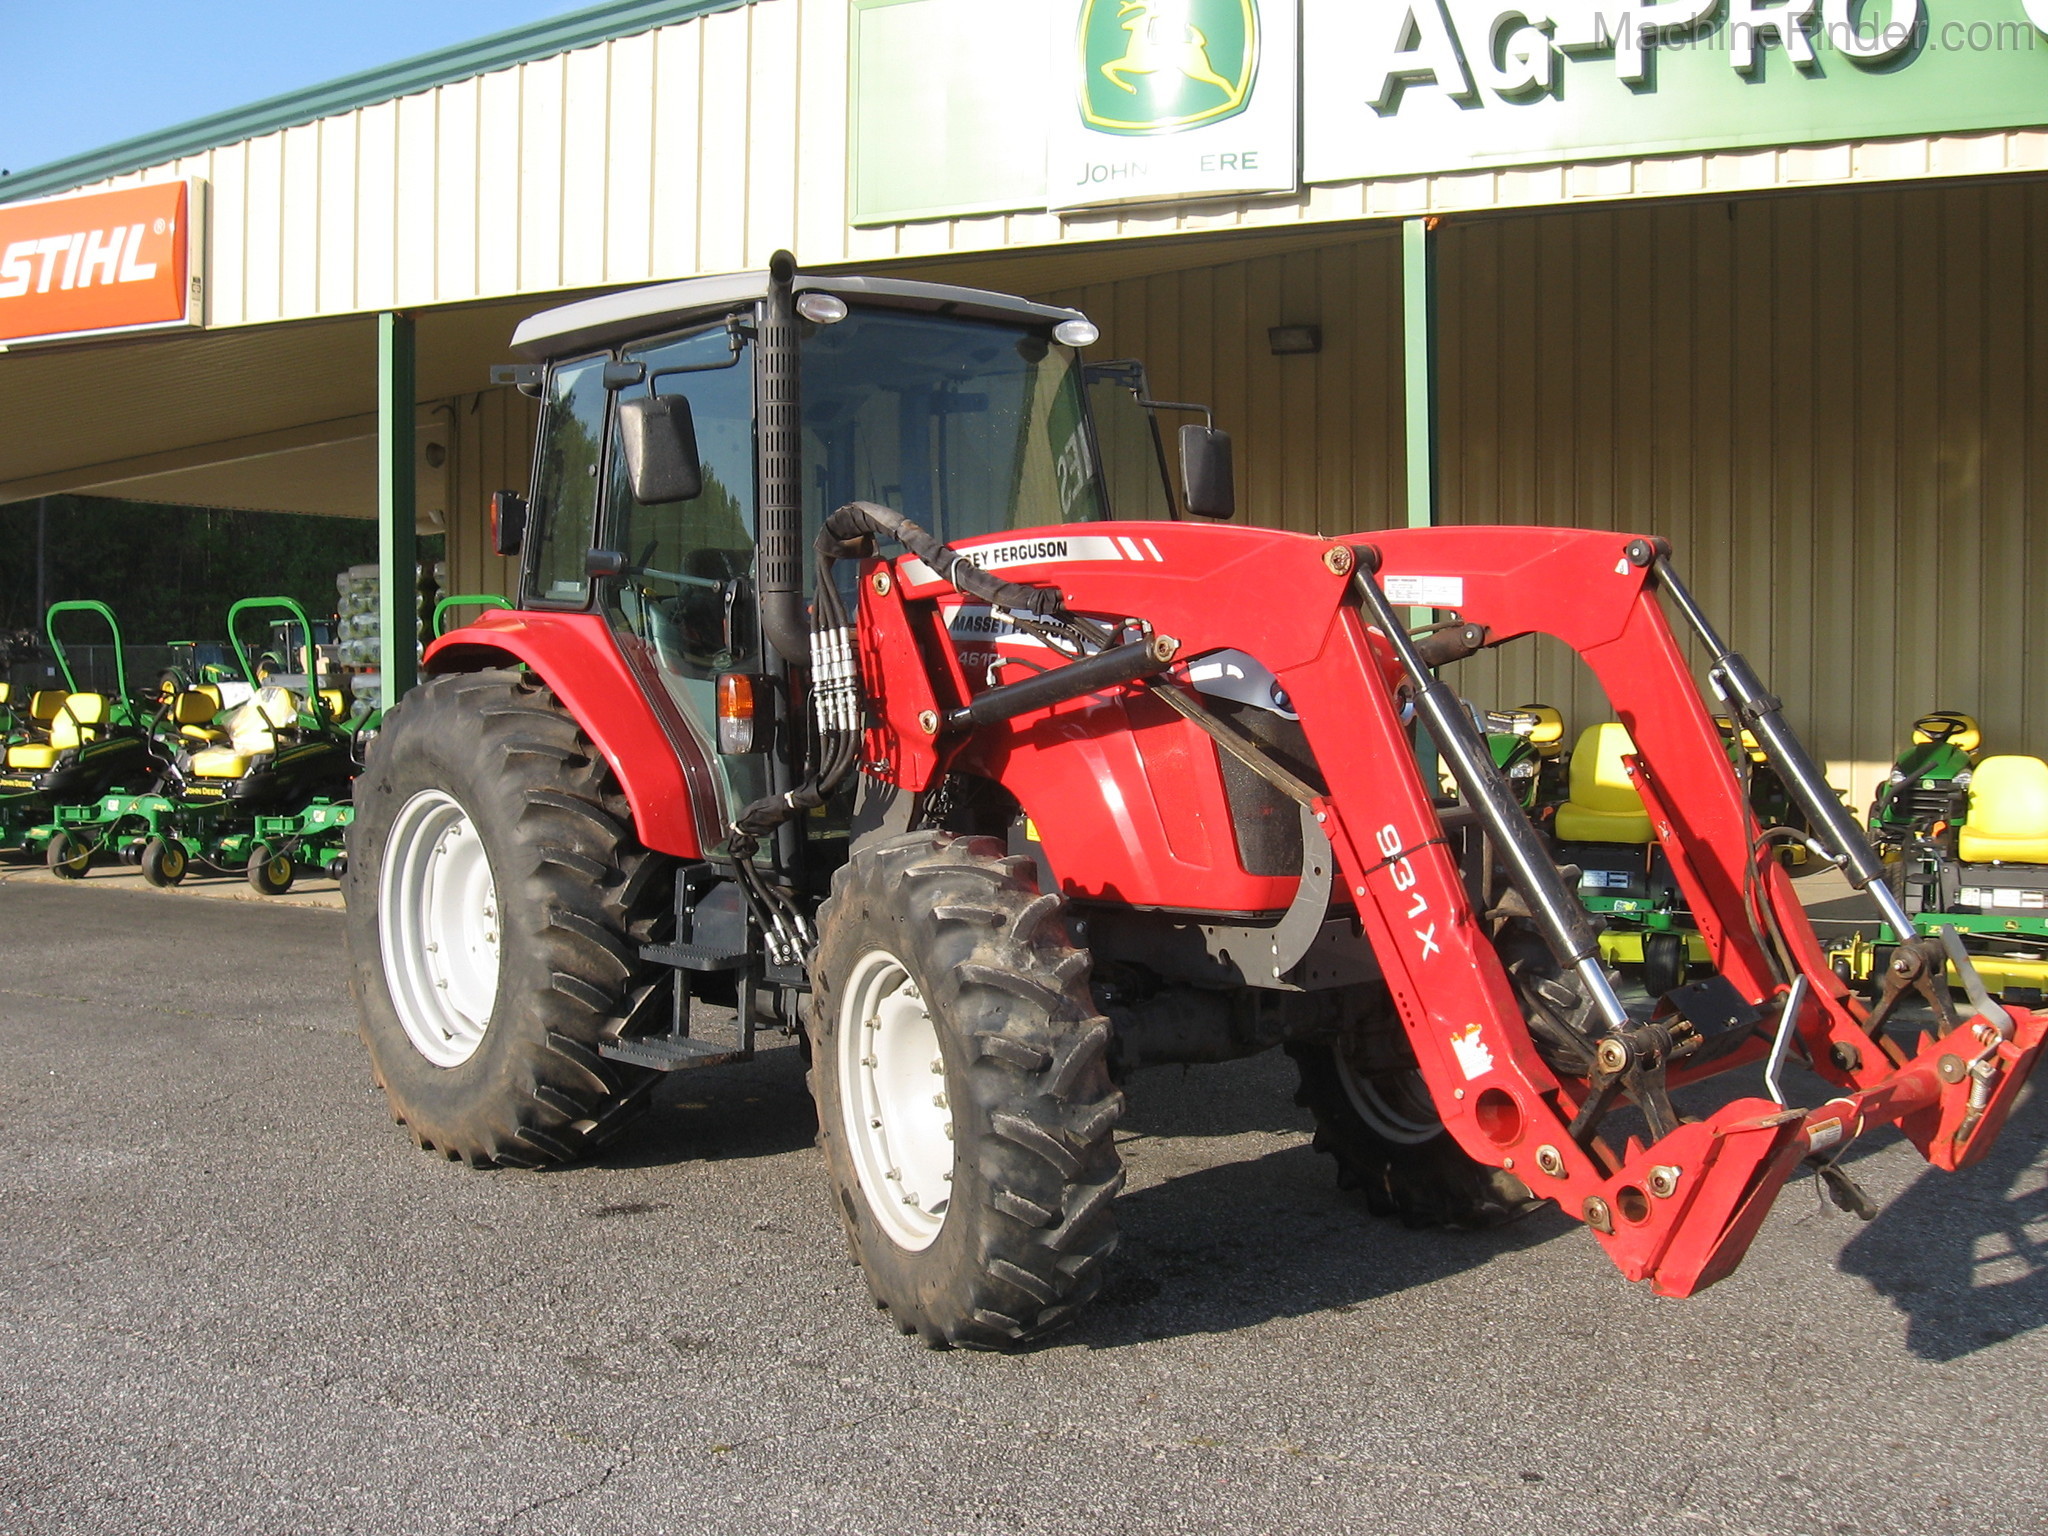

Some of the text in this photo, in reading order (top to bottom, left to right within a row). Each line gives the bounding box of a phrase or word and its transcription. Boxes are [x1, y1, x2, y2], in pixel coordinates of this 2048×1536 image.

[1077, 151, 1258, 186] JOHN ERE
[994, 541, 1068, 563] FERGUSON
[1376, 823, 1441, 962] 931X
